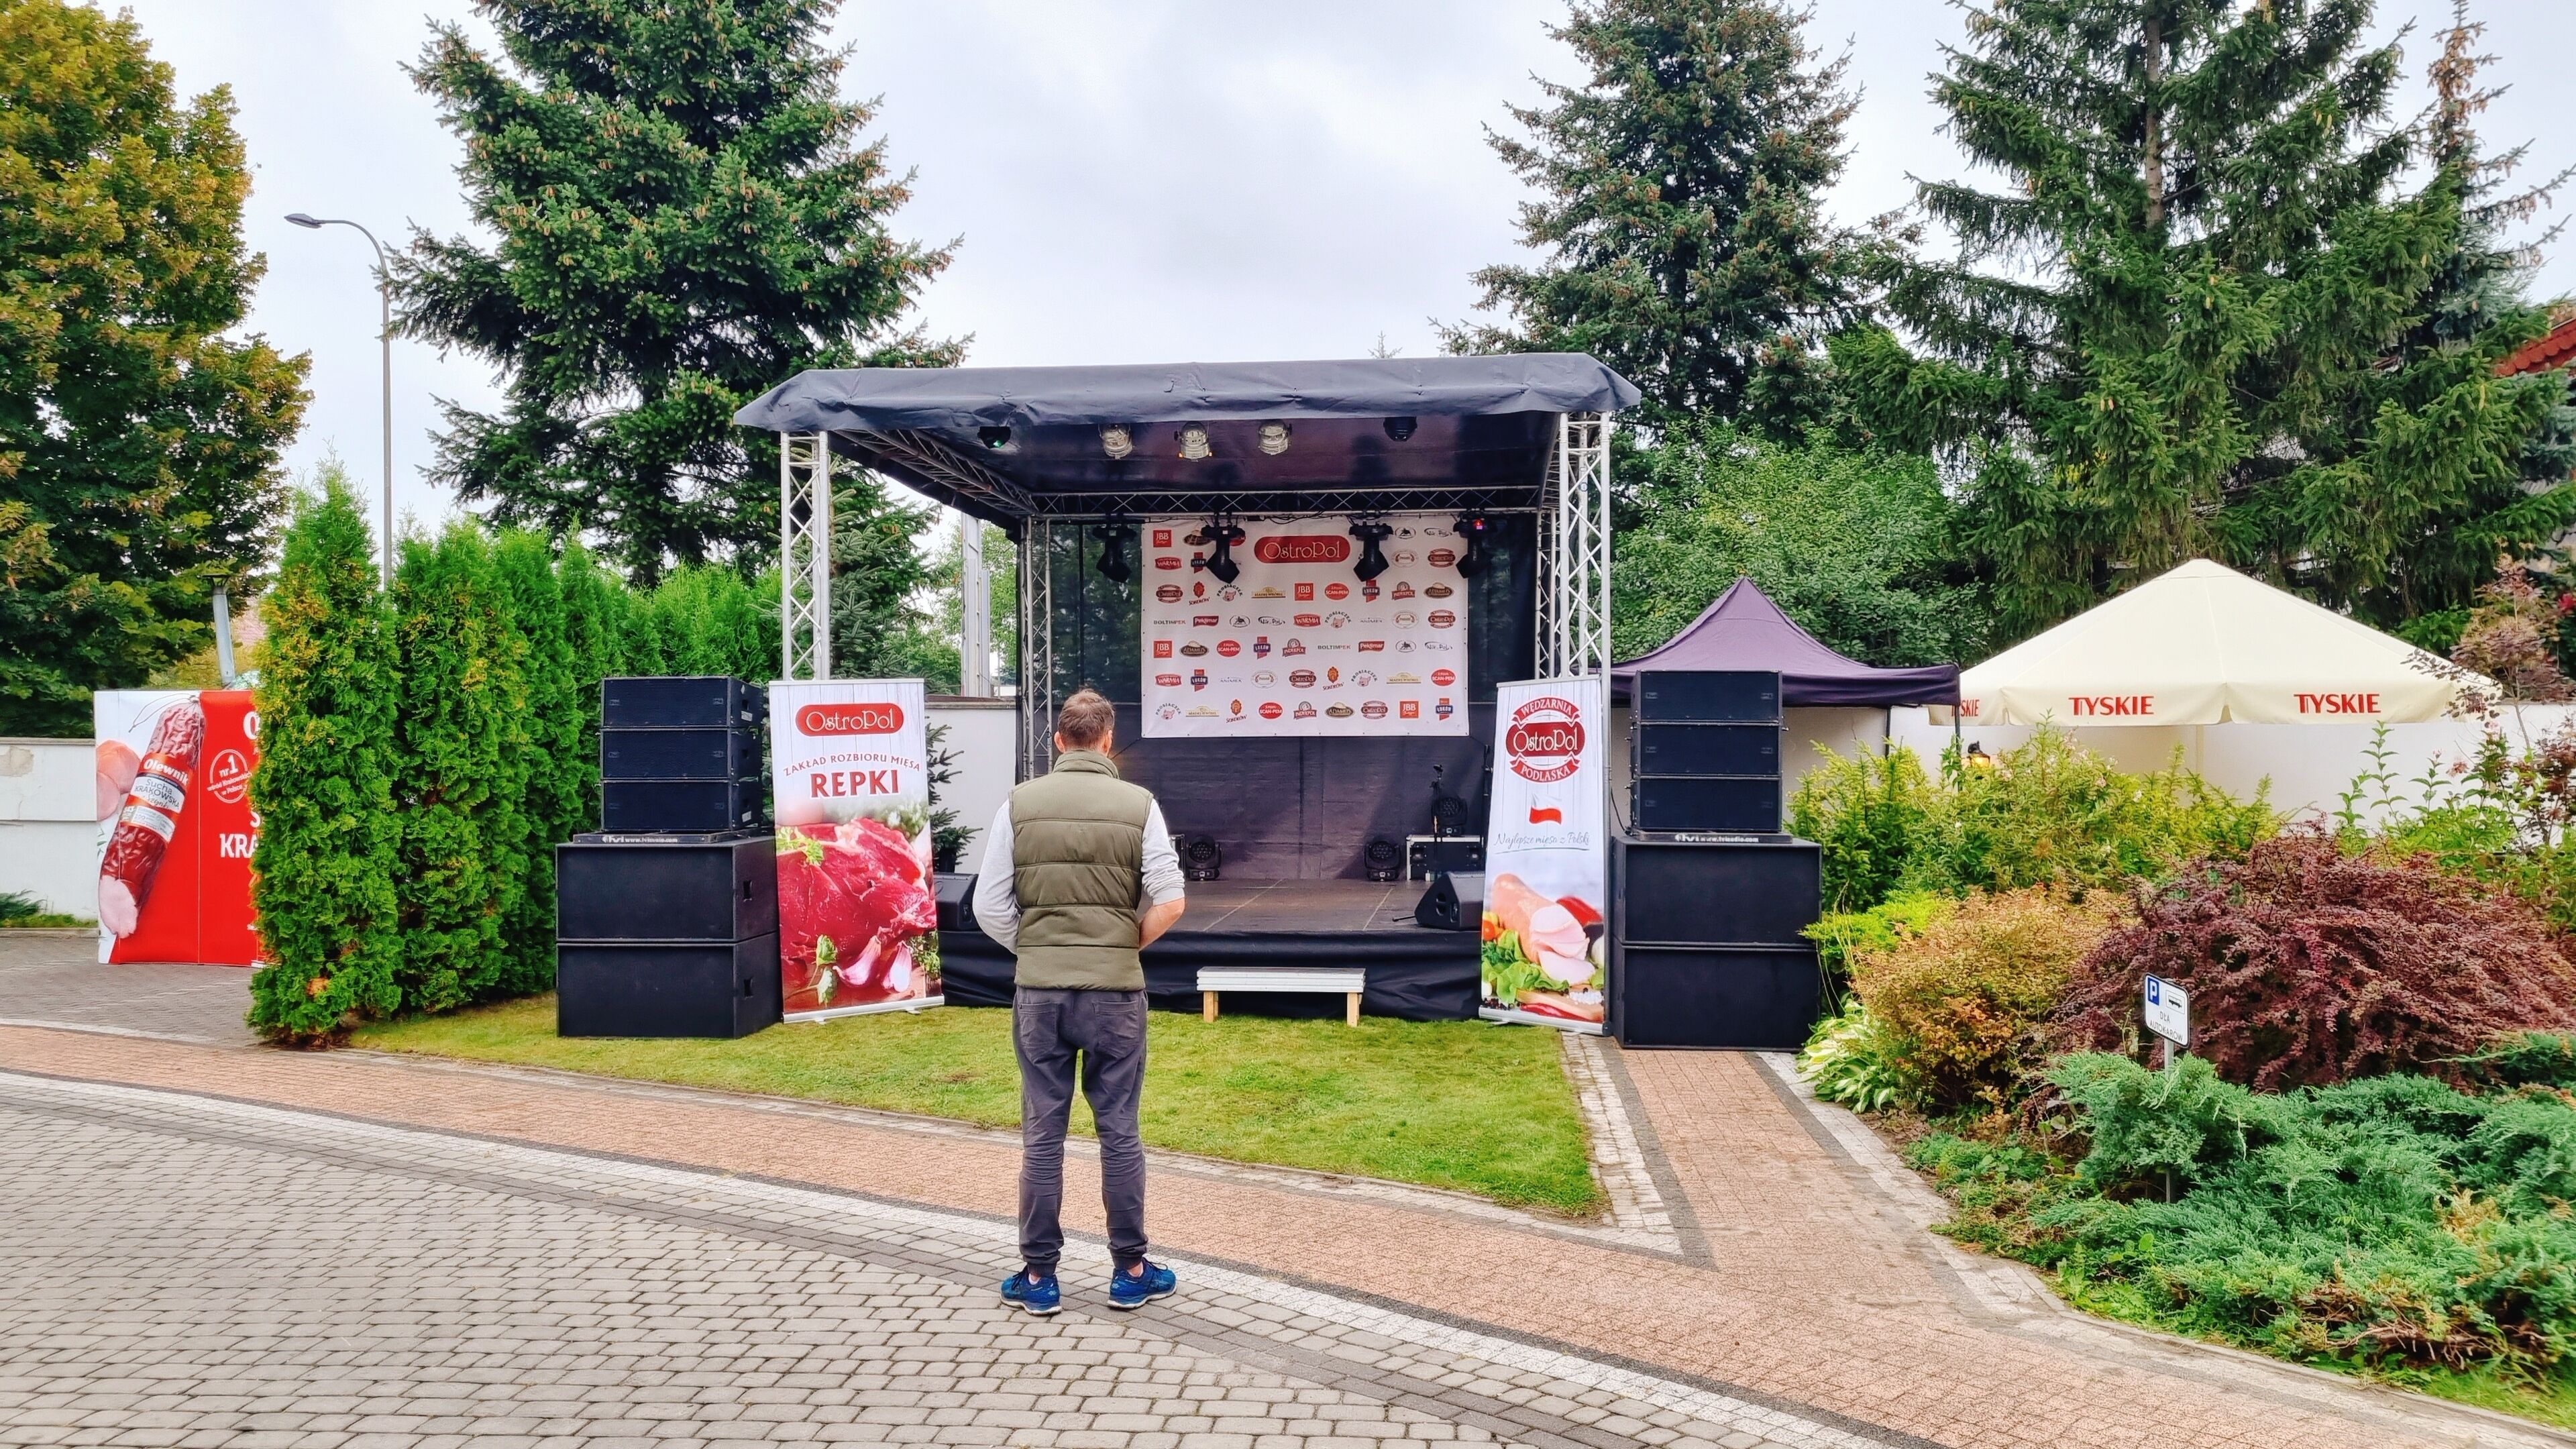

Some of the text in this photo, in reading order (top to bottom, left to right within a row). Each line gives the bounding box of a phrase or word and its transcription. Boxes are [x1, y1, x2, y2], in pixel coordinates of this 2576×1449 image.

[1156, 533, 1169, 541] JBB
[1264, 541, 1340, 559] OstroPol
[1216, 584, 1243, 597] PROSIACZEK
[1297, 585, 1311, 594] JBB
[1325, 610, 1352, 623] PROSIACZEK
[1157, 643, 1170, 651] JBB
[1351, 669, 1378, 682] PROSIACZEK
[1155, 702, 1182, 715] PROSIACZEK
[1403, 703, 1416, 711] JBB
[1521, 698, 1572, 716] WĘDZARNIA
[2068, 696, 2155, 716] TYSKIE
[2293, 693, 2381, 714] TYSKIE
[806, 708, 895, 732] OstroPol
[1513, 727, 1578, 752] OstroPol
[144, 758, 189, 786] Olewnik
[219, 755, 239, 778] nr 1
[784, 756, 826, 777] ZAKŁAD
[830, 753, 887, 763] ROZBIORU
[1520, 765, 1571, 782] PODLASKA
[146, 779, 172, 794] Sucha
[810, 769, 899, 798] REPKI
[135, 785, 180, 810] KRAKOWSKA
[1494, 833, 1535, 849] Najlepsze
[1560, 836, 1566, 844] z
[1567, 832, 1590, 846] Polski
[2150, 980, 2157, 1000] P
[2149, 1020, 2184, 1042] AUTOKARÓW
